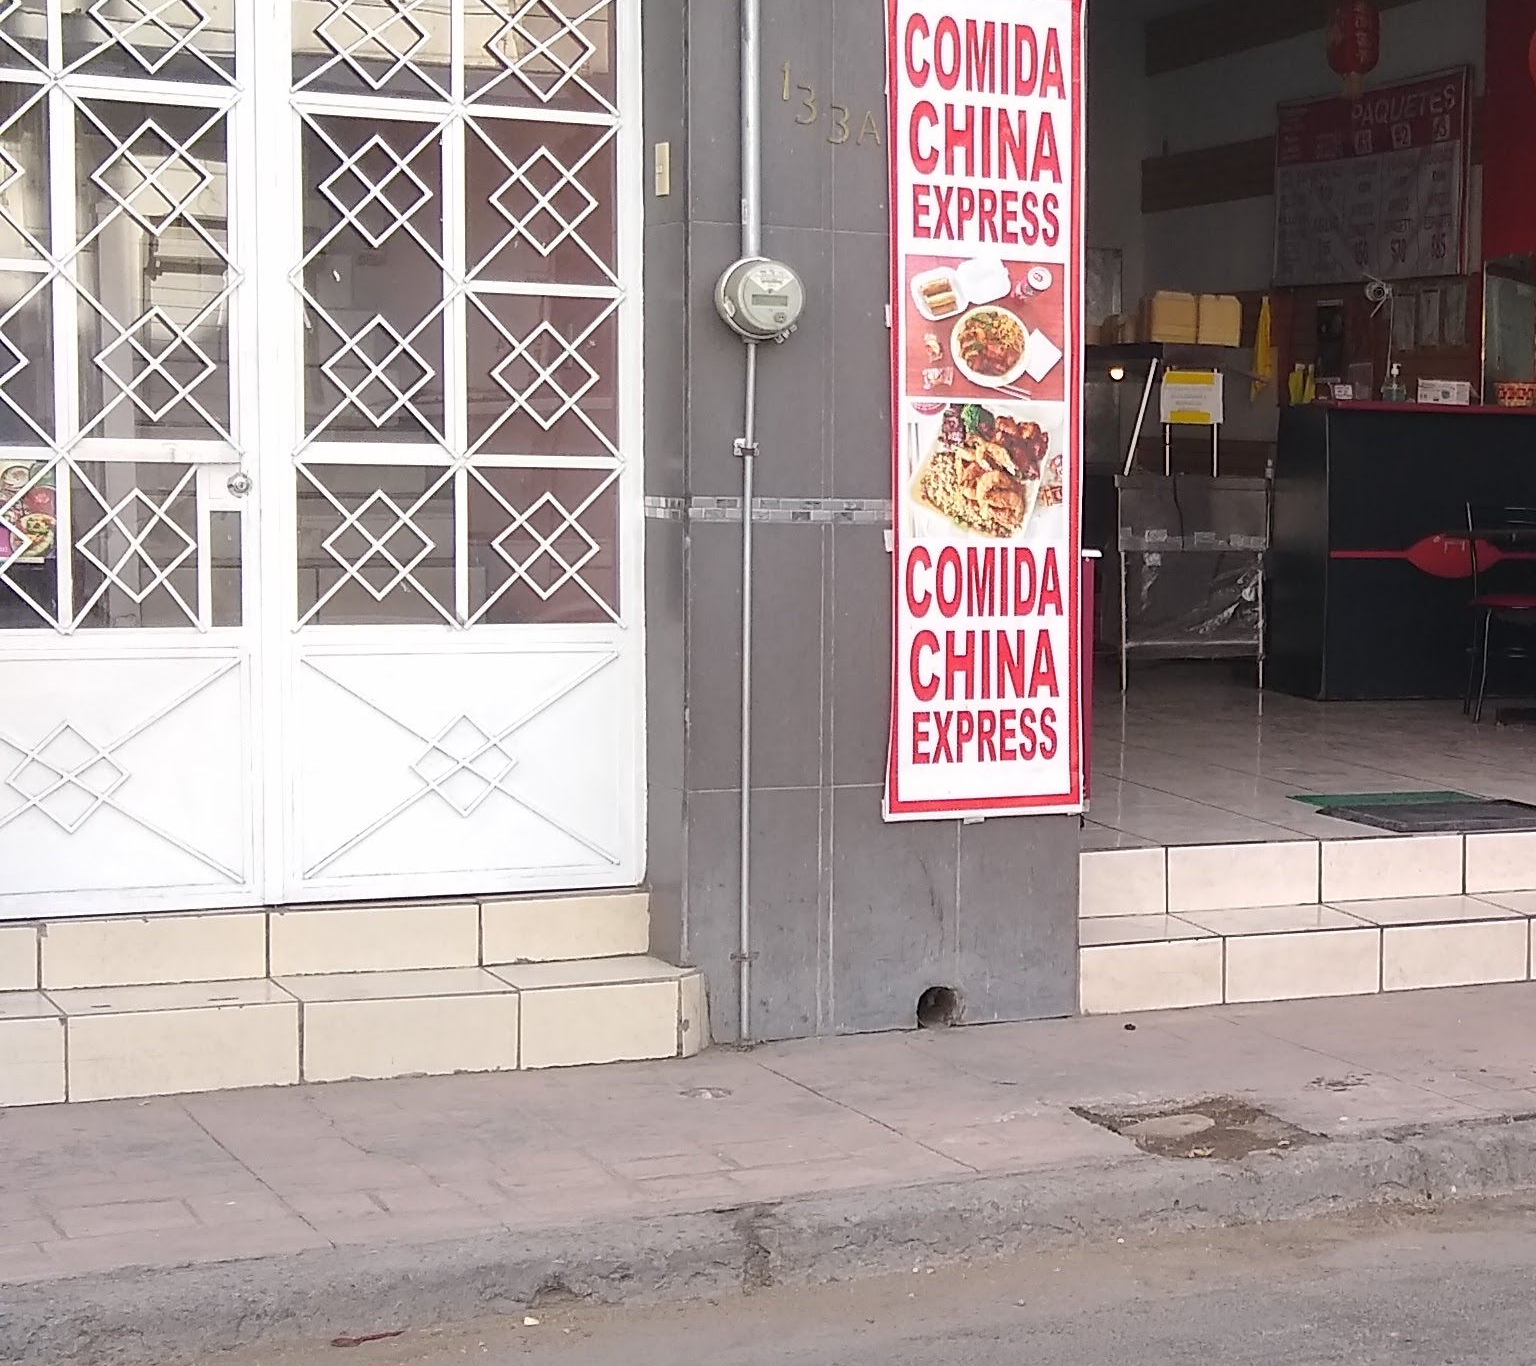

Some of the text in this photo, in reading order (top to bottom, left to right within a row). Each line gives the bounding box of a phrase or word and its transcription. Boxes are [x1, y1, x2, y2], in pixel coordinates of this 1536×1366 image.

[904, 12, 1067, 100] COMIDA
[781, 61, 881, 146] 133A
[909, 100, 1063, 184] CHINA
[912, 184, 1060, 247] EXPRESS
[905, 545, 1064, 619] COMIDA
[910, 629, 1060, 702] CHINA
[912, 707, 1058, 765] EXPRESS
